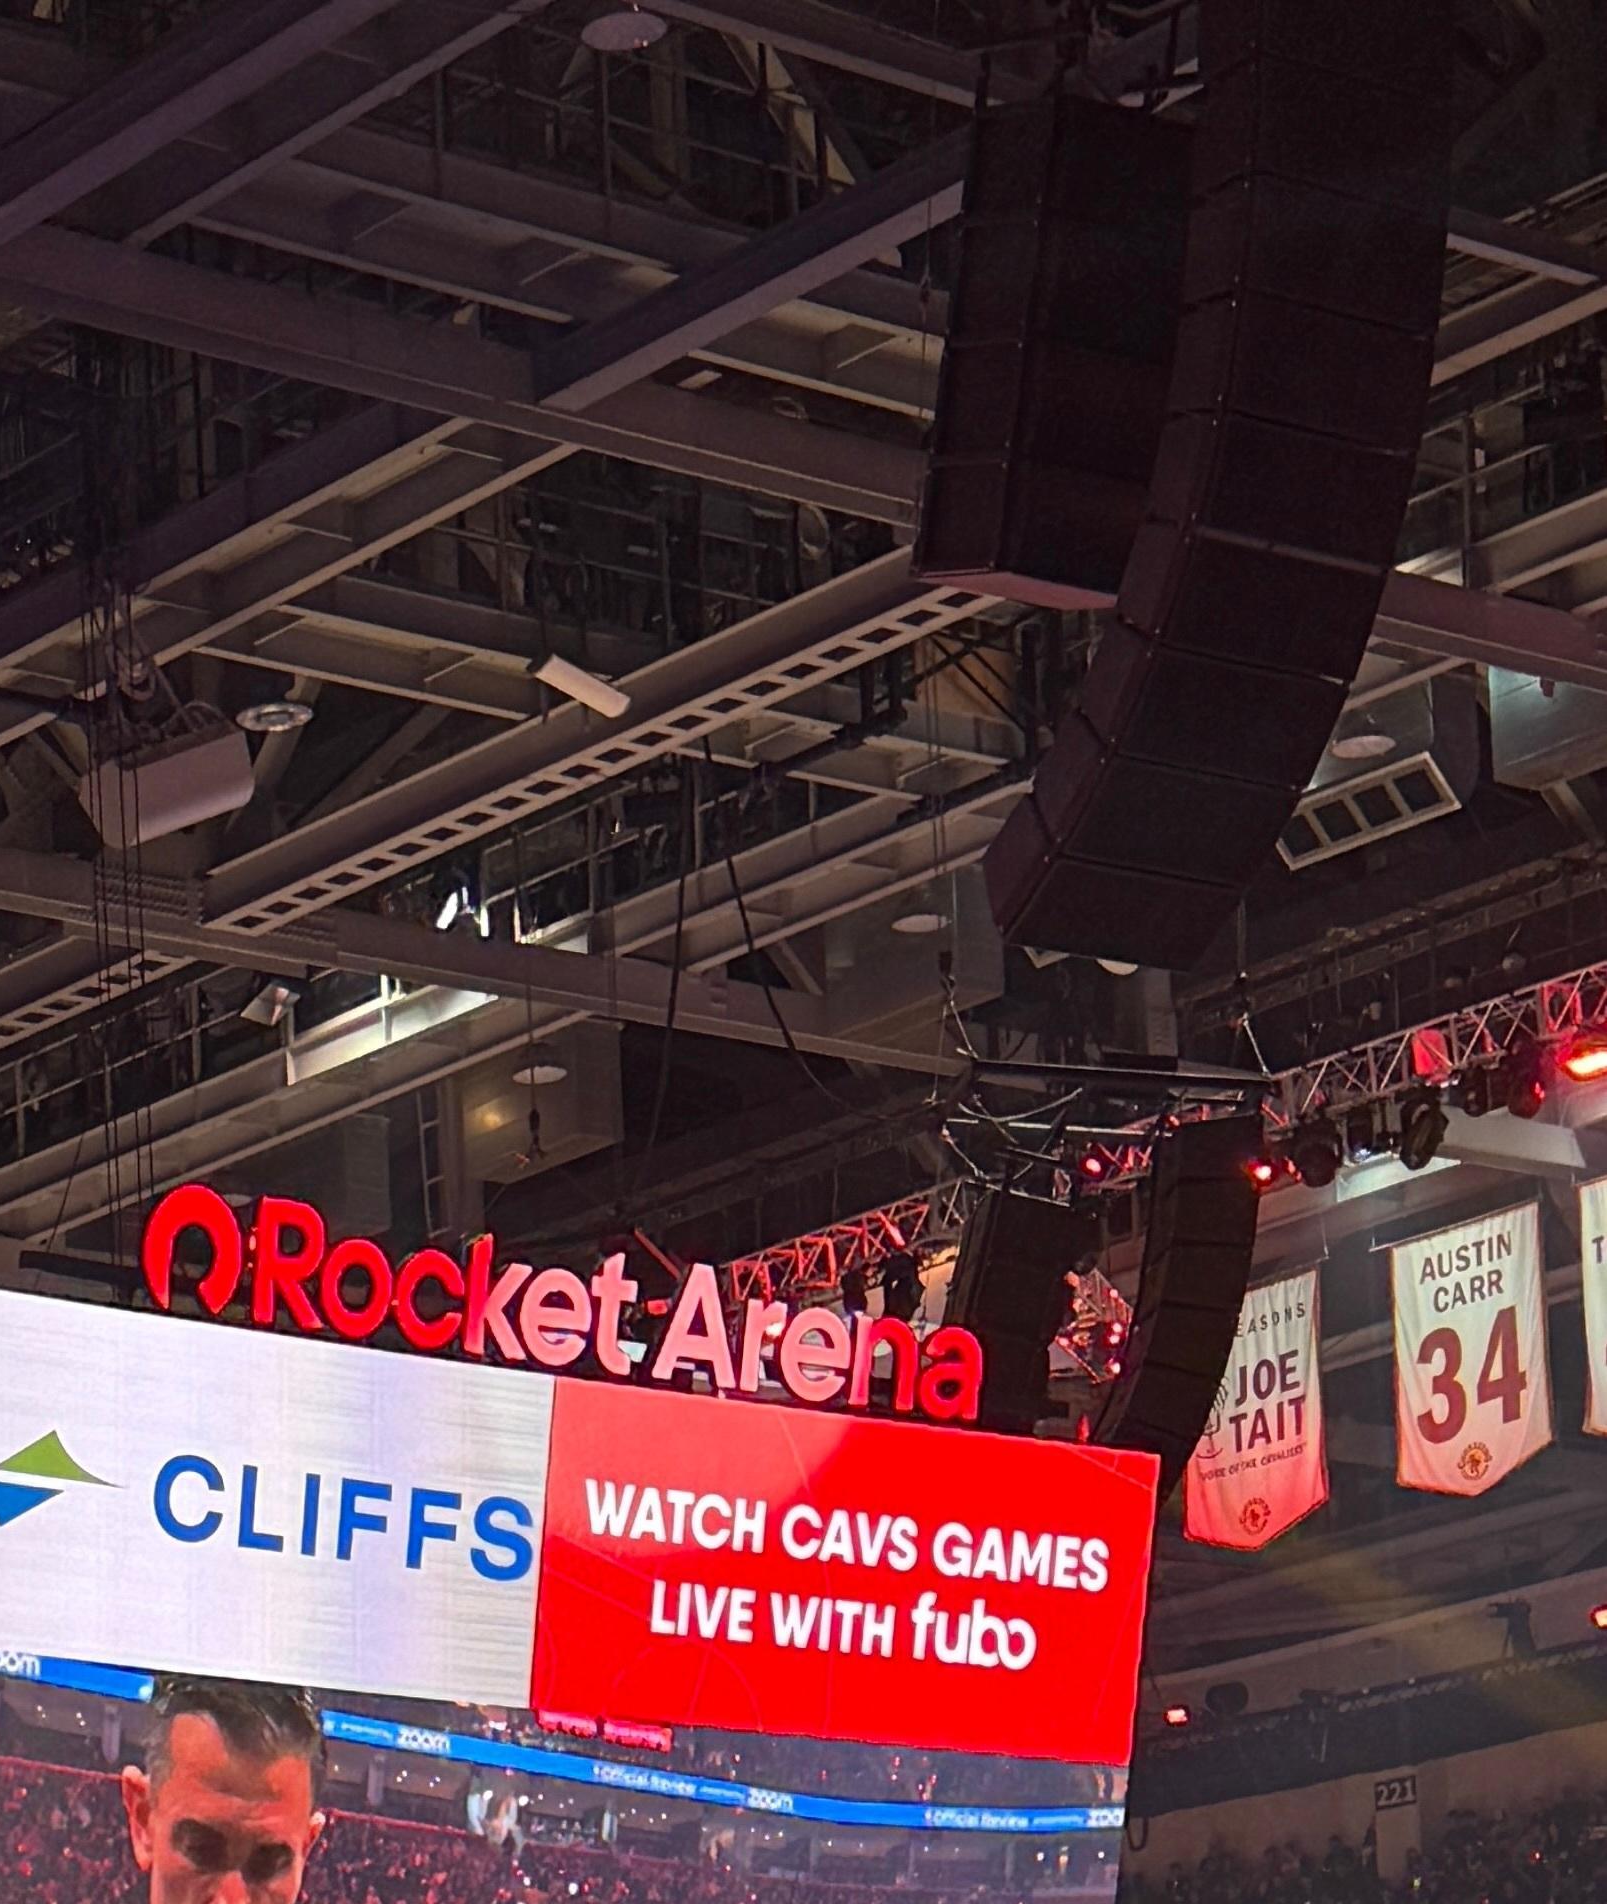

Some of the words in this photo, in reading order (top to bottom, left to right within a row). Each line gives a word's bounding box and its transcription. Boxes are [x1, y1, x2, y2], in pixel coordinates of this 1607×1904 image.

[1419, 1231, 1513, 1286] AUSTIN
[251, 1193, 639, 1376] Rocket
[651, 1262, 984, 1422] Arena
[1235, 1302, 1306, 1338] EASONS
[1433, 1267, 1505, 1315] CARR
[1234, 1349, 1301, 1408] JOE
[1415, 1304, 1529, 1445] 34
[1228, 1393, 1308, 1453] TAIT
[152, 1453, 534, 1582] CLIFFS
[584, 1478, 768, 1555] WATCH
[781, 1503, 919, 1573] CAVS
[931, 1521, 1110, 1593] GAMES
[649, 1579, 757, 1644] LIVE
[769, 1591, 897, 1658] WITH
[910, 1590, 1038, 1671] fubo
[1377, 1780, 1413, 1804] 221
